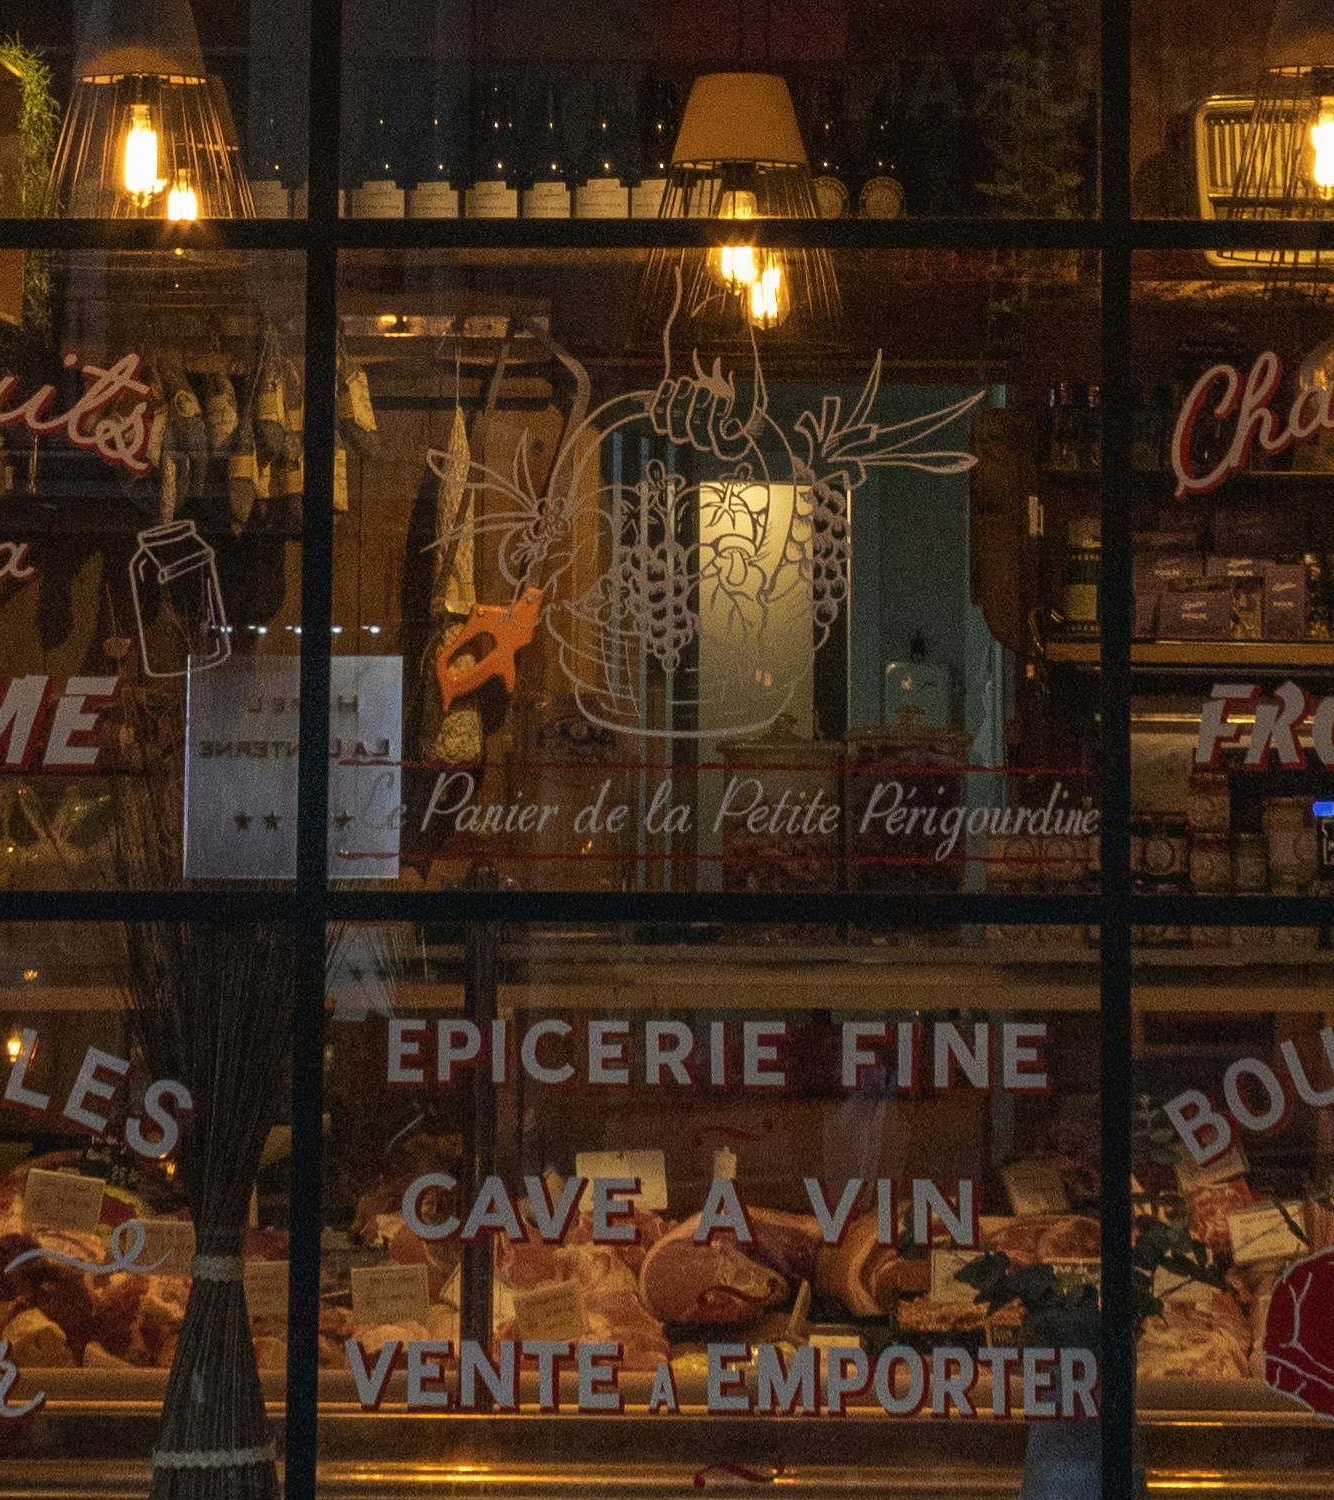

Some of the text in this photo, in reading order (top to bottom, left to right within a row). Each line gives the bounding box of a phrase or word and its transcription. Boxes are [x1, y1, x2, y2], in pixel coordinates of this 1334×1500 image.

[419, 771, 560, 836] Panier
[573, 779, 627, 836] de
[644, 779, 692, 836] la
[711, 777, 840, 836] Petite
[859, 780, 1101, 862] Périgourdine
[385, 1018, 1051, 1090] EPICERIE FINE
[400, 1172, 643, 1245] CAVE
[803, 1177, 978, 1247] VIN
[345, 1339, 1101, 1420] VENTE A EMPORTER
